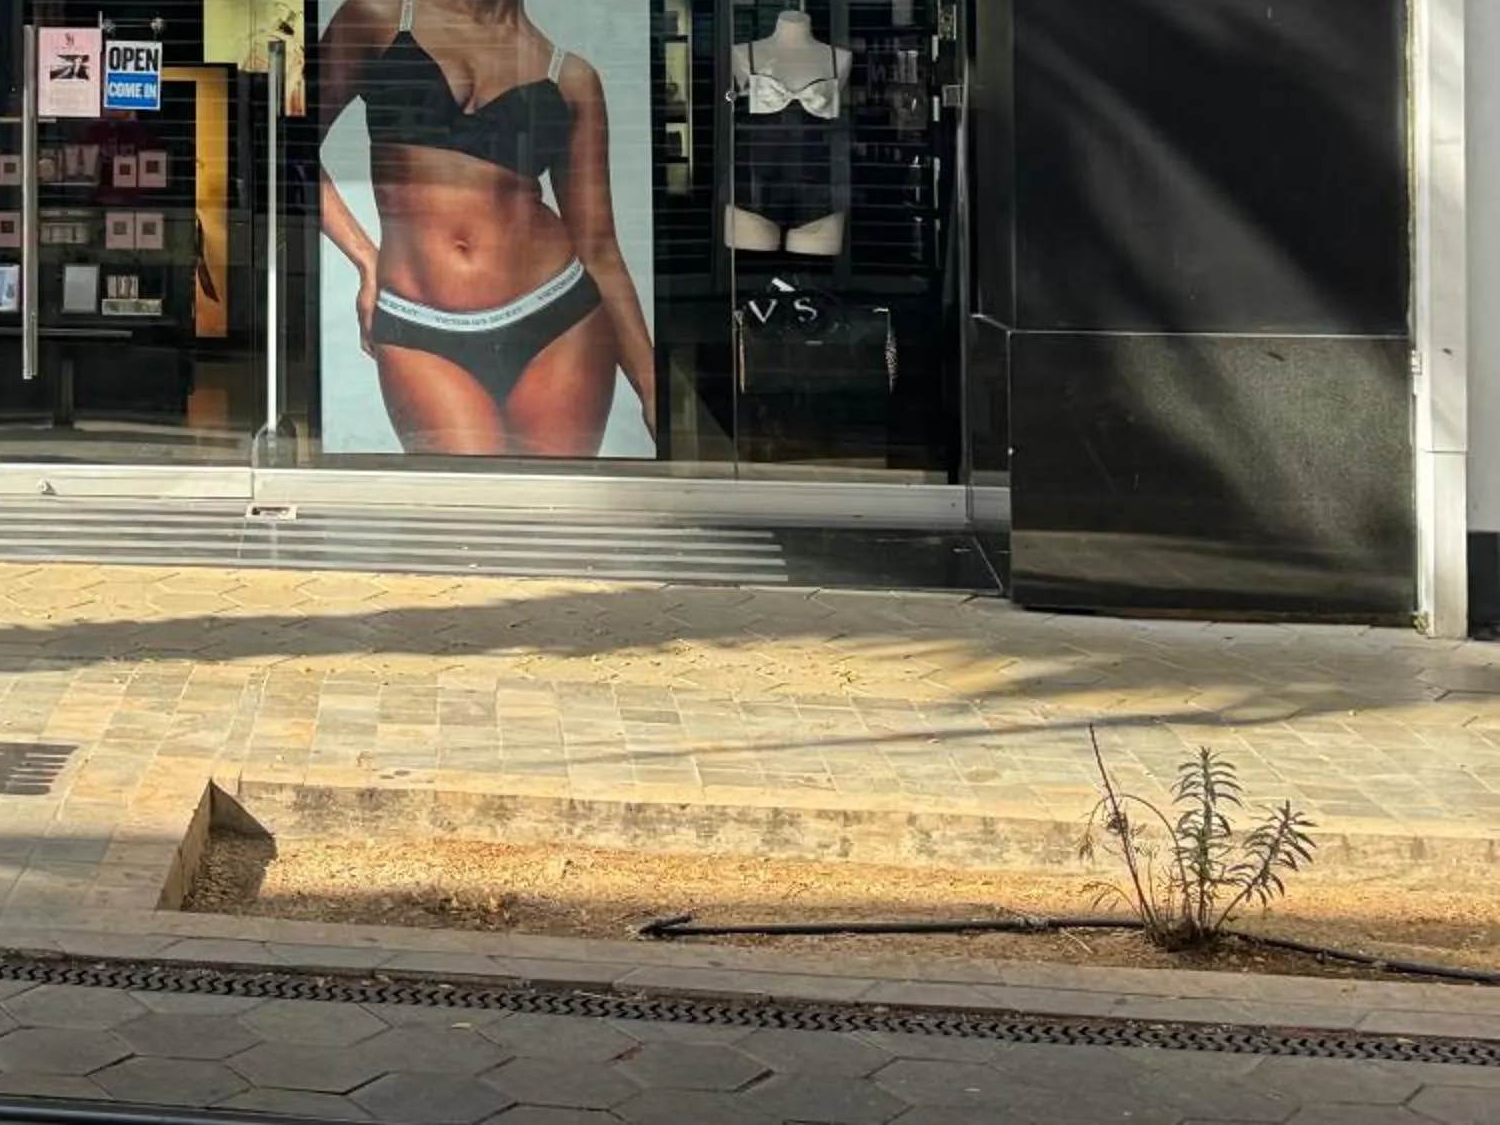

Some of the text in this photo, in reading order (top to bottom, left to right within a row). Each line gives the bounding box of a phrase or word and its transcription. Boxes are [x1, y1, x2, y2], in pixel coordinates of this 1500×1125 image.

[108, 46, 160, 72] OPEN
[108, 81, 144, 99] COME
[144, 82, 158, 99] IN
